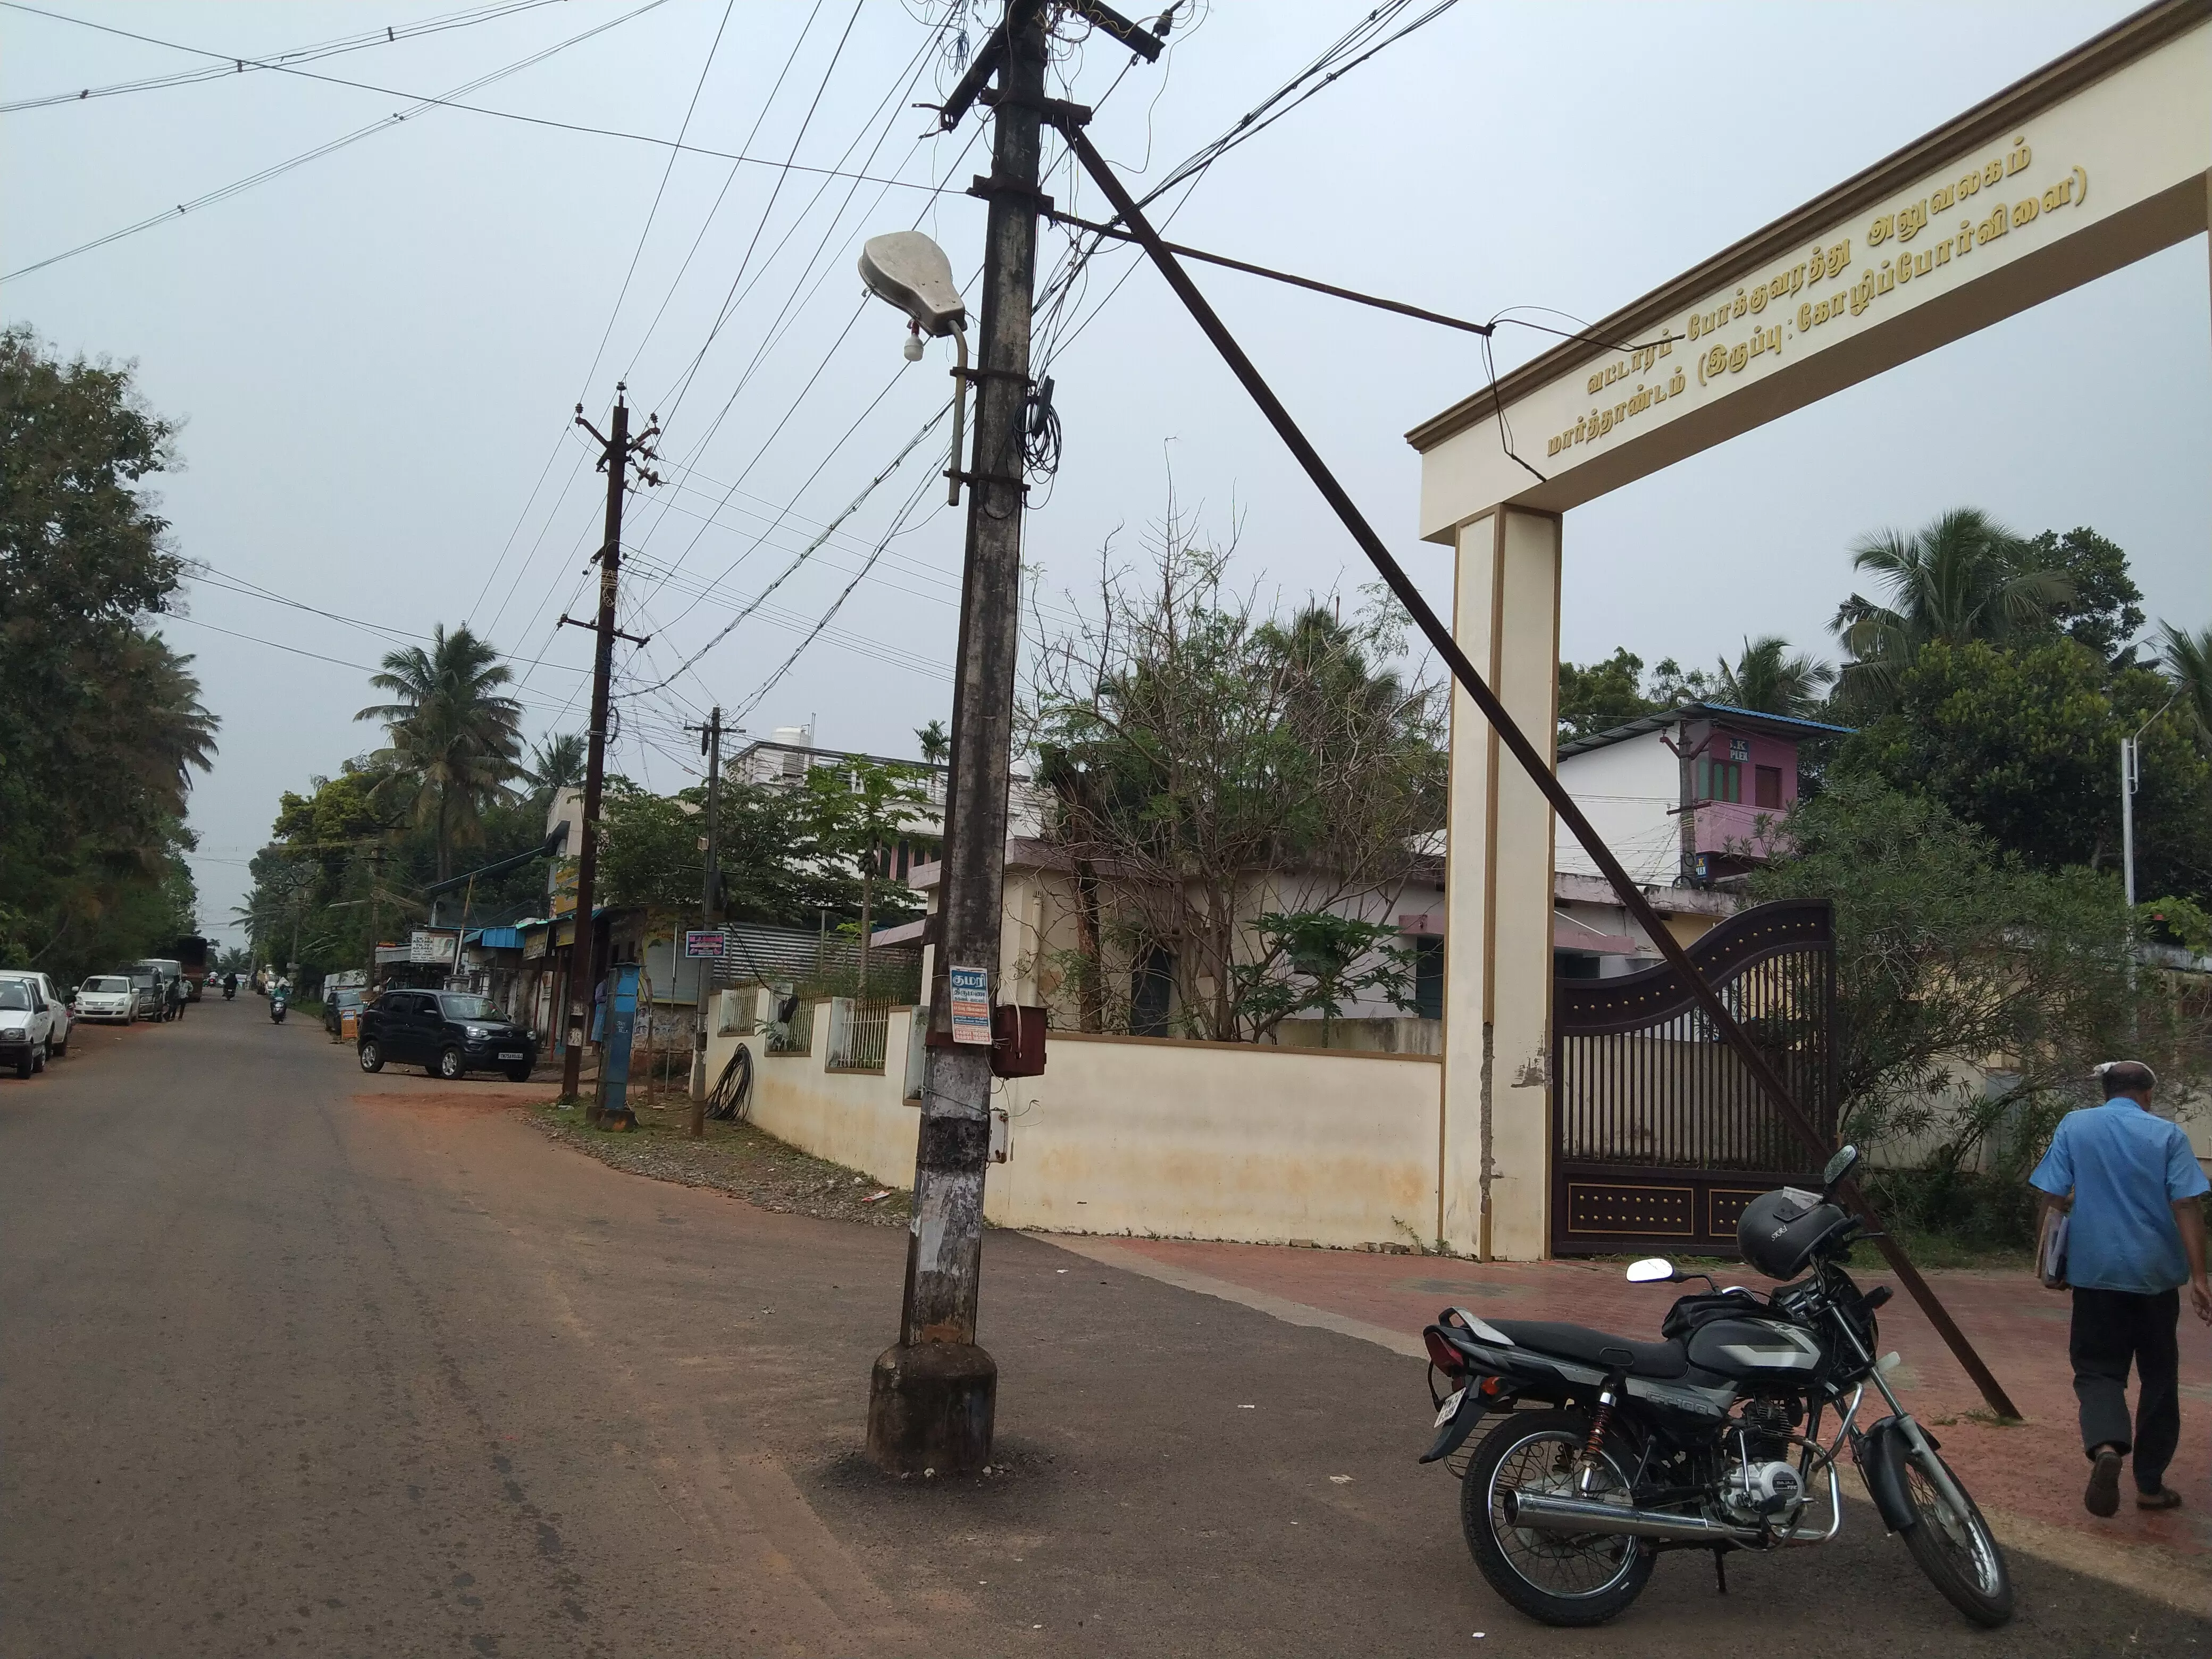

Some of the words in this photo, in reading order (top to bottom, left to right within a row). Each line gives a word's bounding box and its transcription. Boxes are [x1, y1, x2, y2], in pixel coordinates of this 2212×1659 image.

[1687, 238, 1851, 341] போக்குவரத்து
[1866, 136, 2032, 247] அலுவலகம்
[1547, 365, 1686, 457] மார்த்தாண்டம்
[952, 974, 986, 988] குமரி
[953, 988, 985, 997] திருமண
